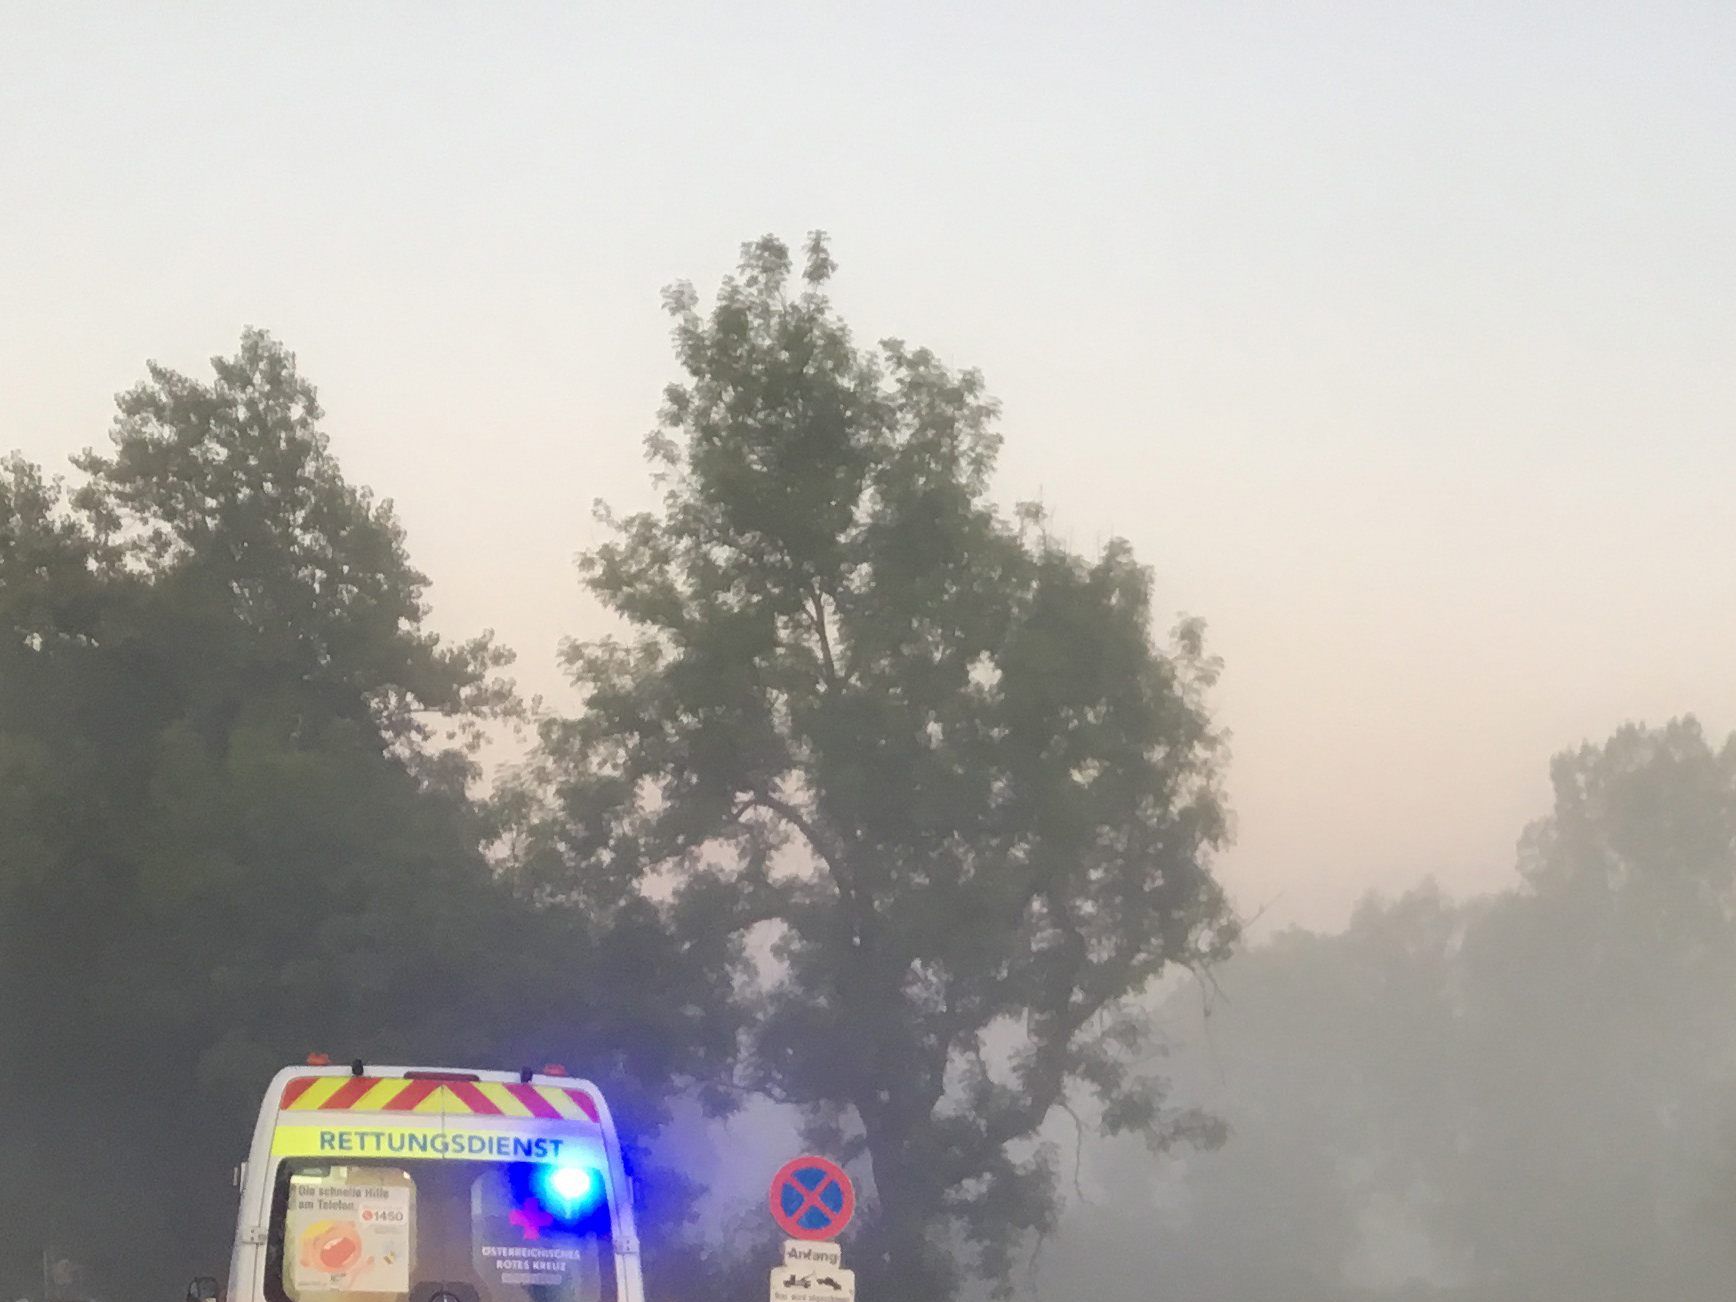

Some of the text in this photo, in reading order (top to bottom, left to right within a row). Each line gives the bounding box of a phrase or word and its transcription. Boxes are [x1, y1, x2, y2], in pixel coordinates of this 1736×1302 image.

[319, 1130, 564, 1158] RETTUNGSDIENST
[788, 1247, 838, 1265] Anfang
[496, 1259, 567, 1272] ROTES KREUZ
